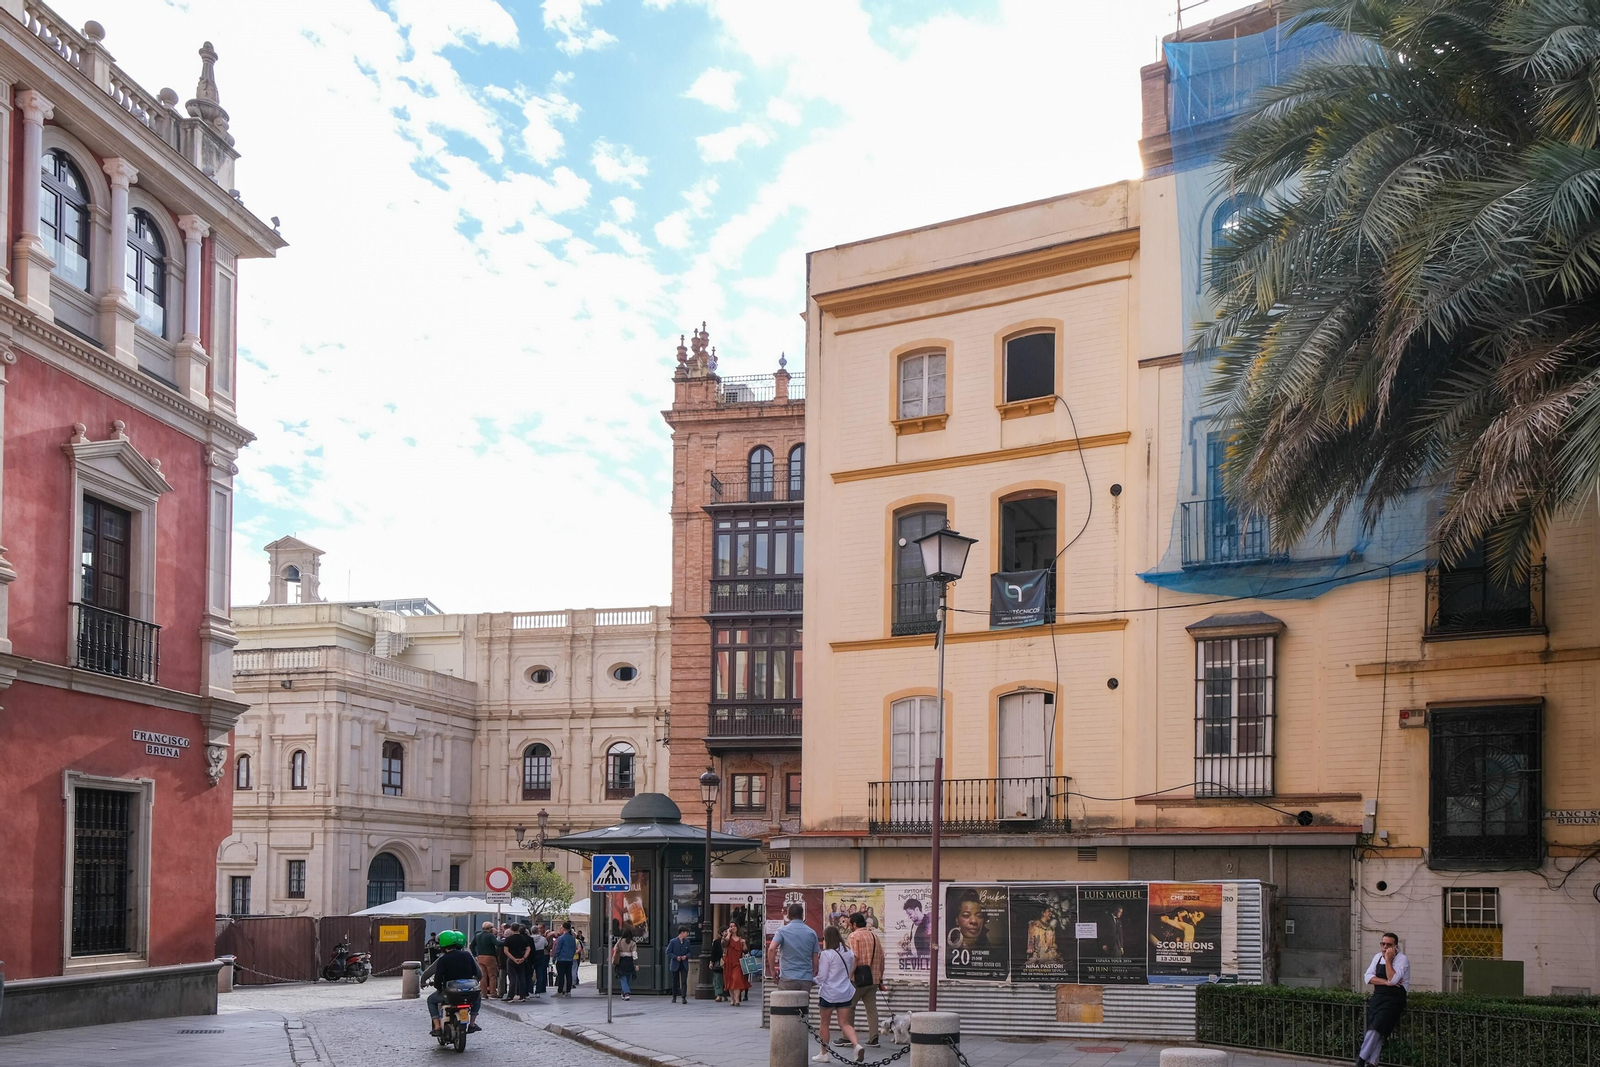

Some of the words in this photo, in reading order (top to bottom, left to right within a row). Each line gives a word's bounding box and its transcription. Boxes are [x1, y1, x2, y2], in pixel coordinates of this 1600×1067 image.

[133, 730, 190, 747] FRANCISCO
[146, 745, 179, 757] BRUNA
[1542, 810, 1600, 818] FRANCIS
[768, 860, 786, 877] BAR
[1084, 891, 1104, 899] LUIS
[1106, 891, 1142, 899] MIGUEL
[1156, 940, 1214, 950] SCORPIONS
[951, 949, 970, 965] 20
[898, 958, 931, 970] SEVILL
